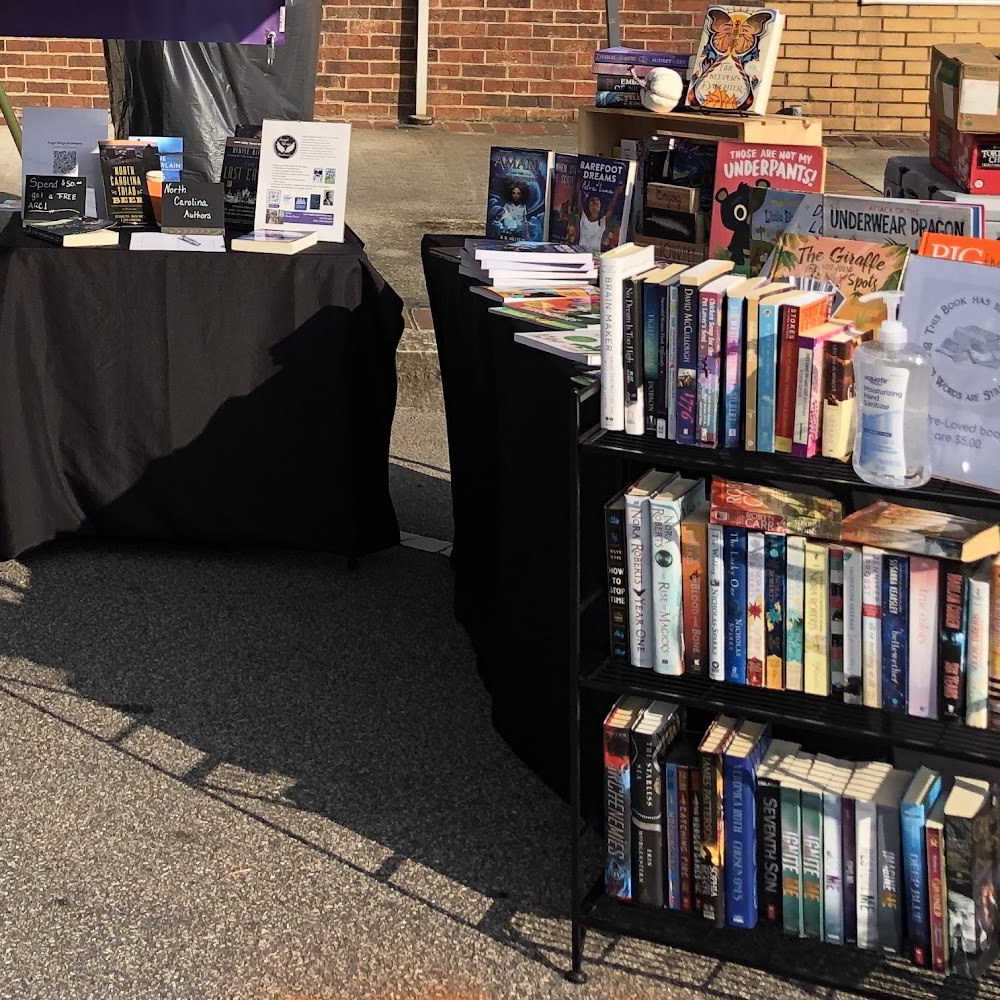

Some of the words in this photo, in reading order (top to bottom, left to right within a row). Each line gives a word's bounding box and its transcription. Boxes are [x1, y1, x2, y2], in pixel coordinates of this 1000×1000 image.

[580, 161, 623, 174] BAREFOOT
[730, 149, 757, 159] THOSE
[760, 149, 776, 159] ARE
[779, 150, 797, 160] NOT
[798, 153, 813, 165] MY
[110, 175, 141, 186] CAROLINA
[114, 166, 135, 175] NORTH
[223, 166, 243, 179] LAST
[583, 172, 616, 183] DREAMS
[723, 158, 818, 188] UNDERPANTS!
[29, 178, 58, 190] Spend
[31, 192, 43, 200] get
[117, 186, 136, 196] TRIAD
[164, 183, 187, 194] North
[174, 196, 208, 207] Carolina
[183, 210, 211, 219] Authors
[830, 209, 907, 235] UNDERWEAR
[911, 217, 965, 237] DRAGON
[798, 246, 825, 264] The
[829, 246, 886, 272] Giraffe
[932, 243, 984, 263] PIG
[604, 277, 613, 311] BRAIN
[625, 287, 633, 298] No
[847, 273, 879, 292] Spots
[684, 288, 693, 310] DAVID
[972, 296, 990, 306] HAS
[604, 314, 613, 352] MAKER
[625, 331, 633, 346] Too
[700, 328, 708, 342] Soul
[707, 322, 715, 337] Soup
[625, 347, 633, 363] High
[864, 375, 888, 385] equate
[864, 385, 902, 398] Moisturizing
[679, 392, 695, 424] 1776
[729, 392, 737, 421] GILBERT
[864, 393, 879, 401] Hand
[864, 400, 890, 410] Sanitizer
[934, 431, 952, 442] are
[955, 435, 982, 449] $5.00
[630, 509, 643, 539] NORA
[652, 508, 665, 548] ROBERTS
[745, 518, 775, 531] CARR
[746, 512, 775, 521] ROBYN
[663, 515, 674, 543] NORA
[730, 532, 738, 547] The
[609, 567, 624, 576] HOW
[631, 543, 643, 585] ROBERTS
[710, 549, 719, 575] Wedding
[729, 551, 738, 576] Lucky
[888, 559, 898, 586] SUSANNA
[609, 586, 626, 595] STOP
[611, 577, 621, 585] TO
[658, 581, 670, 602] RISE
[730, 578, 739, 597] One
[809, 571, 818, 596] NORA
[946, 572, 962, 603] HARLAN
[610, 595, 626, 605] TIME
[691, 584, 700, 614] BLOOD
[711, 588, 719, 626] NICHOLAS
[888, 586, 899, 615] KEARSLEY
[634, 598, 645, 625] YEAR
[809, 598, 818, 630] ROBERTS
[946, 603, 961, 629] COBEN
[635, 629, 646, 652] ONE
[659, 611, 671, 654] MAGICKS
[692, 628, 701, 653] BONE
[711, 627, 719, 655] SPARKS
[734, 619, 742, 657] NICHOLAS
[890, 630, 901, 683] bellewether
[701, 757, 711, 786] JAMES
[732, 764, 743, 806] VERONICA
[607, 763, 627, 860] ARCHENEMIES
[702, 788, 713, 842] PATTERSON
[733, 808, 743, 833] ROTH
[679, 806, 687, 852] CATCHING
[693, 817, 701, 851] HUNGER
[763, 797, 777, 860] SEVENTH
[732, 840, 743, 876] CHOSEN
[782, 831, 799, 874] IGNITE
[803, 835, 820, 878] IGNITE
[680, 856, 688, 879] FIRE
[765, 861, 779, 893] SON
[882, 850, 896, 892] IMAGINE
[909, 853, 919, 887] DEEP
[709, 866, 718, 897] SOPHIA
[732, 877, 743, 901] ONES
[783, 877, 799, 898] ME
[804, 881, 819, 902] ME
[826, 875, 840, 893] ME
[860, 894, 875, 912] ME
